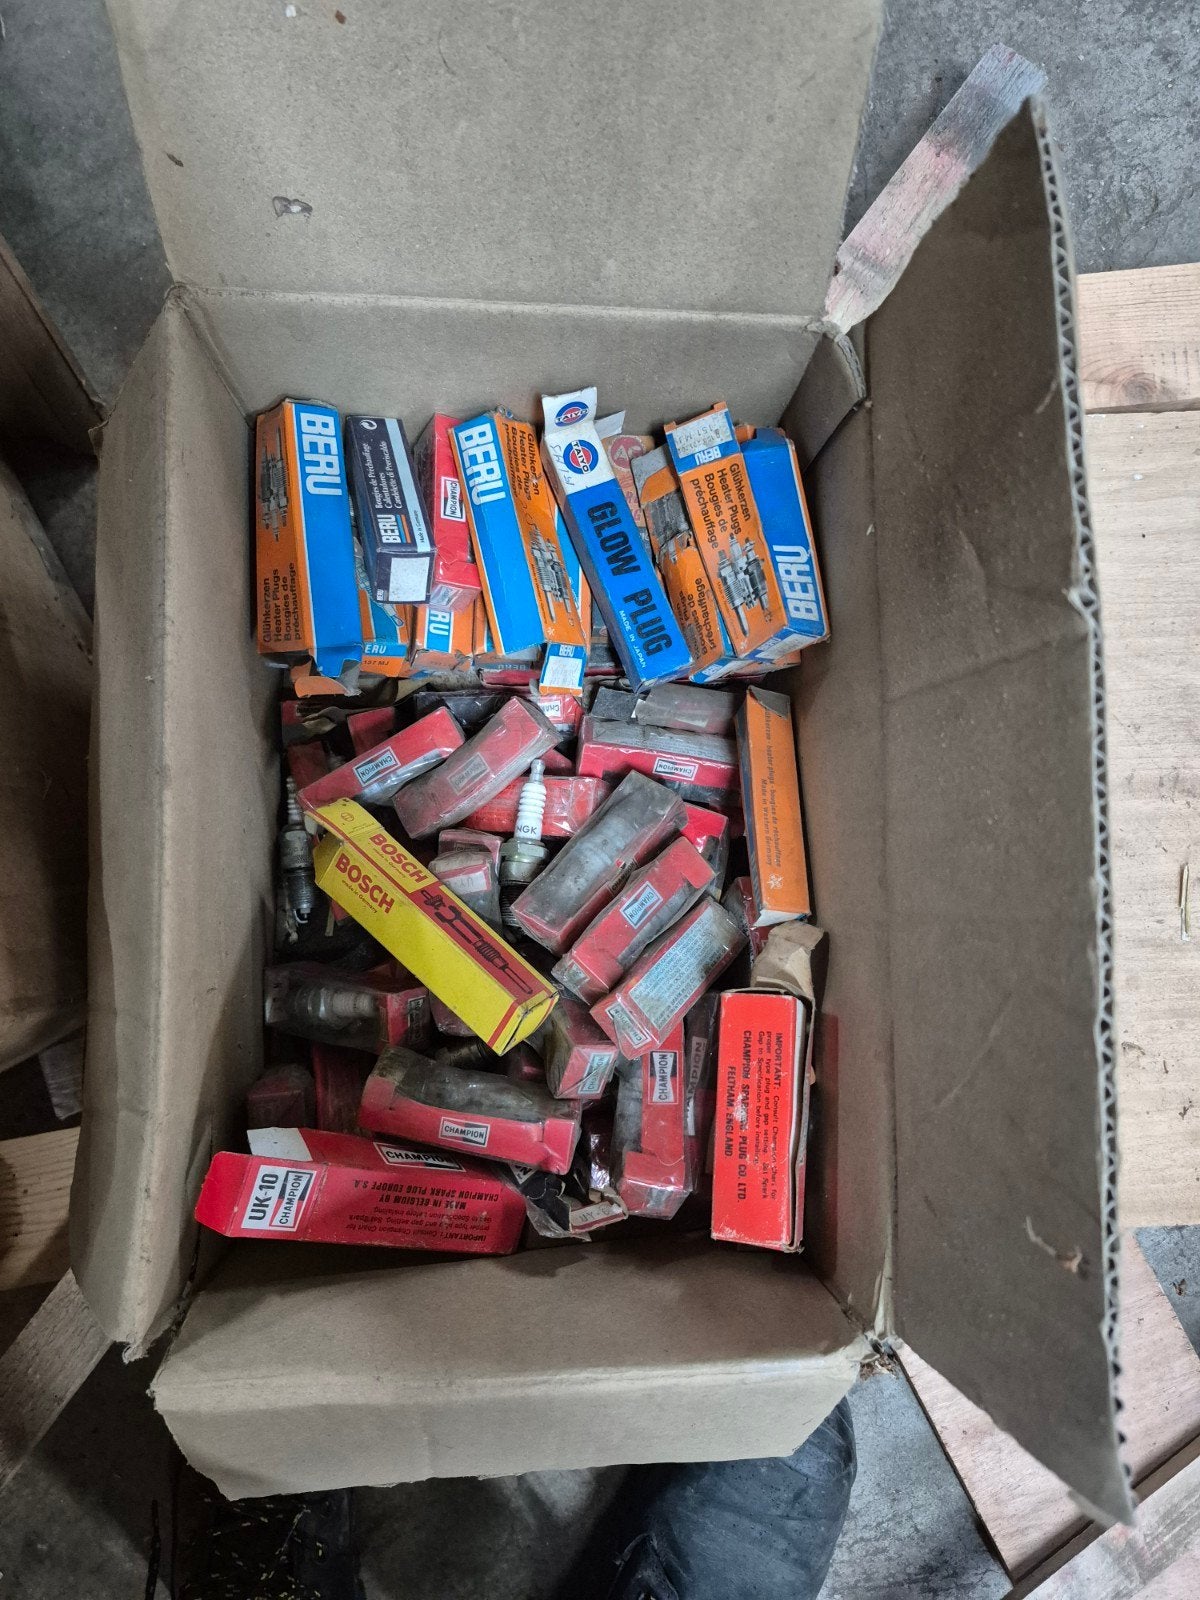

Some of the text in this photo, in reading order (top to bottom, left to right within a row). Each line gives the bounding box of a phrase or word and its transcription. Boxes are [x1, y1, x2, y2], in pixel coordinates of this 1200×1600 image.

[556, 408, 588, 422] TAIYO
[300, 412, 342, 495] BERU
[458, 423, 506, 505] BERU
[512, 426, 520, 472] Bougies
[518, 430, 532, 502] Heater Plugs
[528, 432, 540, 495] Glühkeren
[573, 442, 589, 472] TAIYO
[694, 446, 722, 466] BERU
[690, 478, 718, 549] préchauffage
[704, 473, 728, 532] Bougies de
[717, 468, 742, 534] Heater Plugs
[730, 463, 750, 520] Glühkerzen
[376, 514, 402, 543] BERU
[588, 502, 641, 576] GLOW
[622, 588, 672, 656] PLUG
[688, 594, 696, 608] de
[772, 544, 820, 622] BERU
[262, 578, 272, 642] Glühkerzen
[272, 568, 282, 642] Heater Plugs
[282, 576, 291, 640] Bougies de
[364, 644, 386, 654] ERU
[619, 610, 646, 668] MADE IN JAPAN
[361, 756, 392, 778] CHAMPION
[658, 762, 692, 774] CHAMPION
[517, 825, 537, 834] NGK
[369, 834, 428, 884] BOSCH
[335, 852, 394, 914] BOSCH
[628, 892, 655, 918] CHAMPION
[658, 1054, 668, 1101] CHAMPION
[742, 1030, 752, 1079] CHAMPION
[774, 1032, 782, 1090] IMPORTANT:
[444, 1125, 484, 1138] CHAMPION
[738, 1136, 748, 1160] PLUG
[371, 1182, 404, 1192] EUROPE
[406, 1184, 428, 1194] PLUG
[430, 1186, 456, 1198] SPARK
[738, 1164, 746, 1179] CO.
[738, 1182, 746, 1202] LTD.
[248, 1172, 278, 1222] UK-10
[279, 1174, 304, 1224] CHAMPION
[379, 1194, 467, 1210] MADE IN BELGIUM BY
[458, 1190, 499, 1202] CHAMPION
